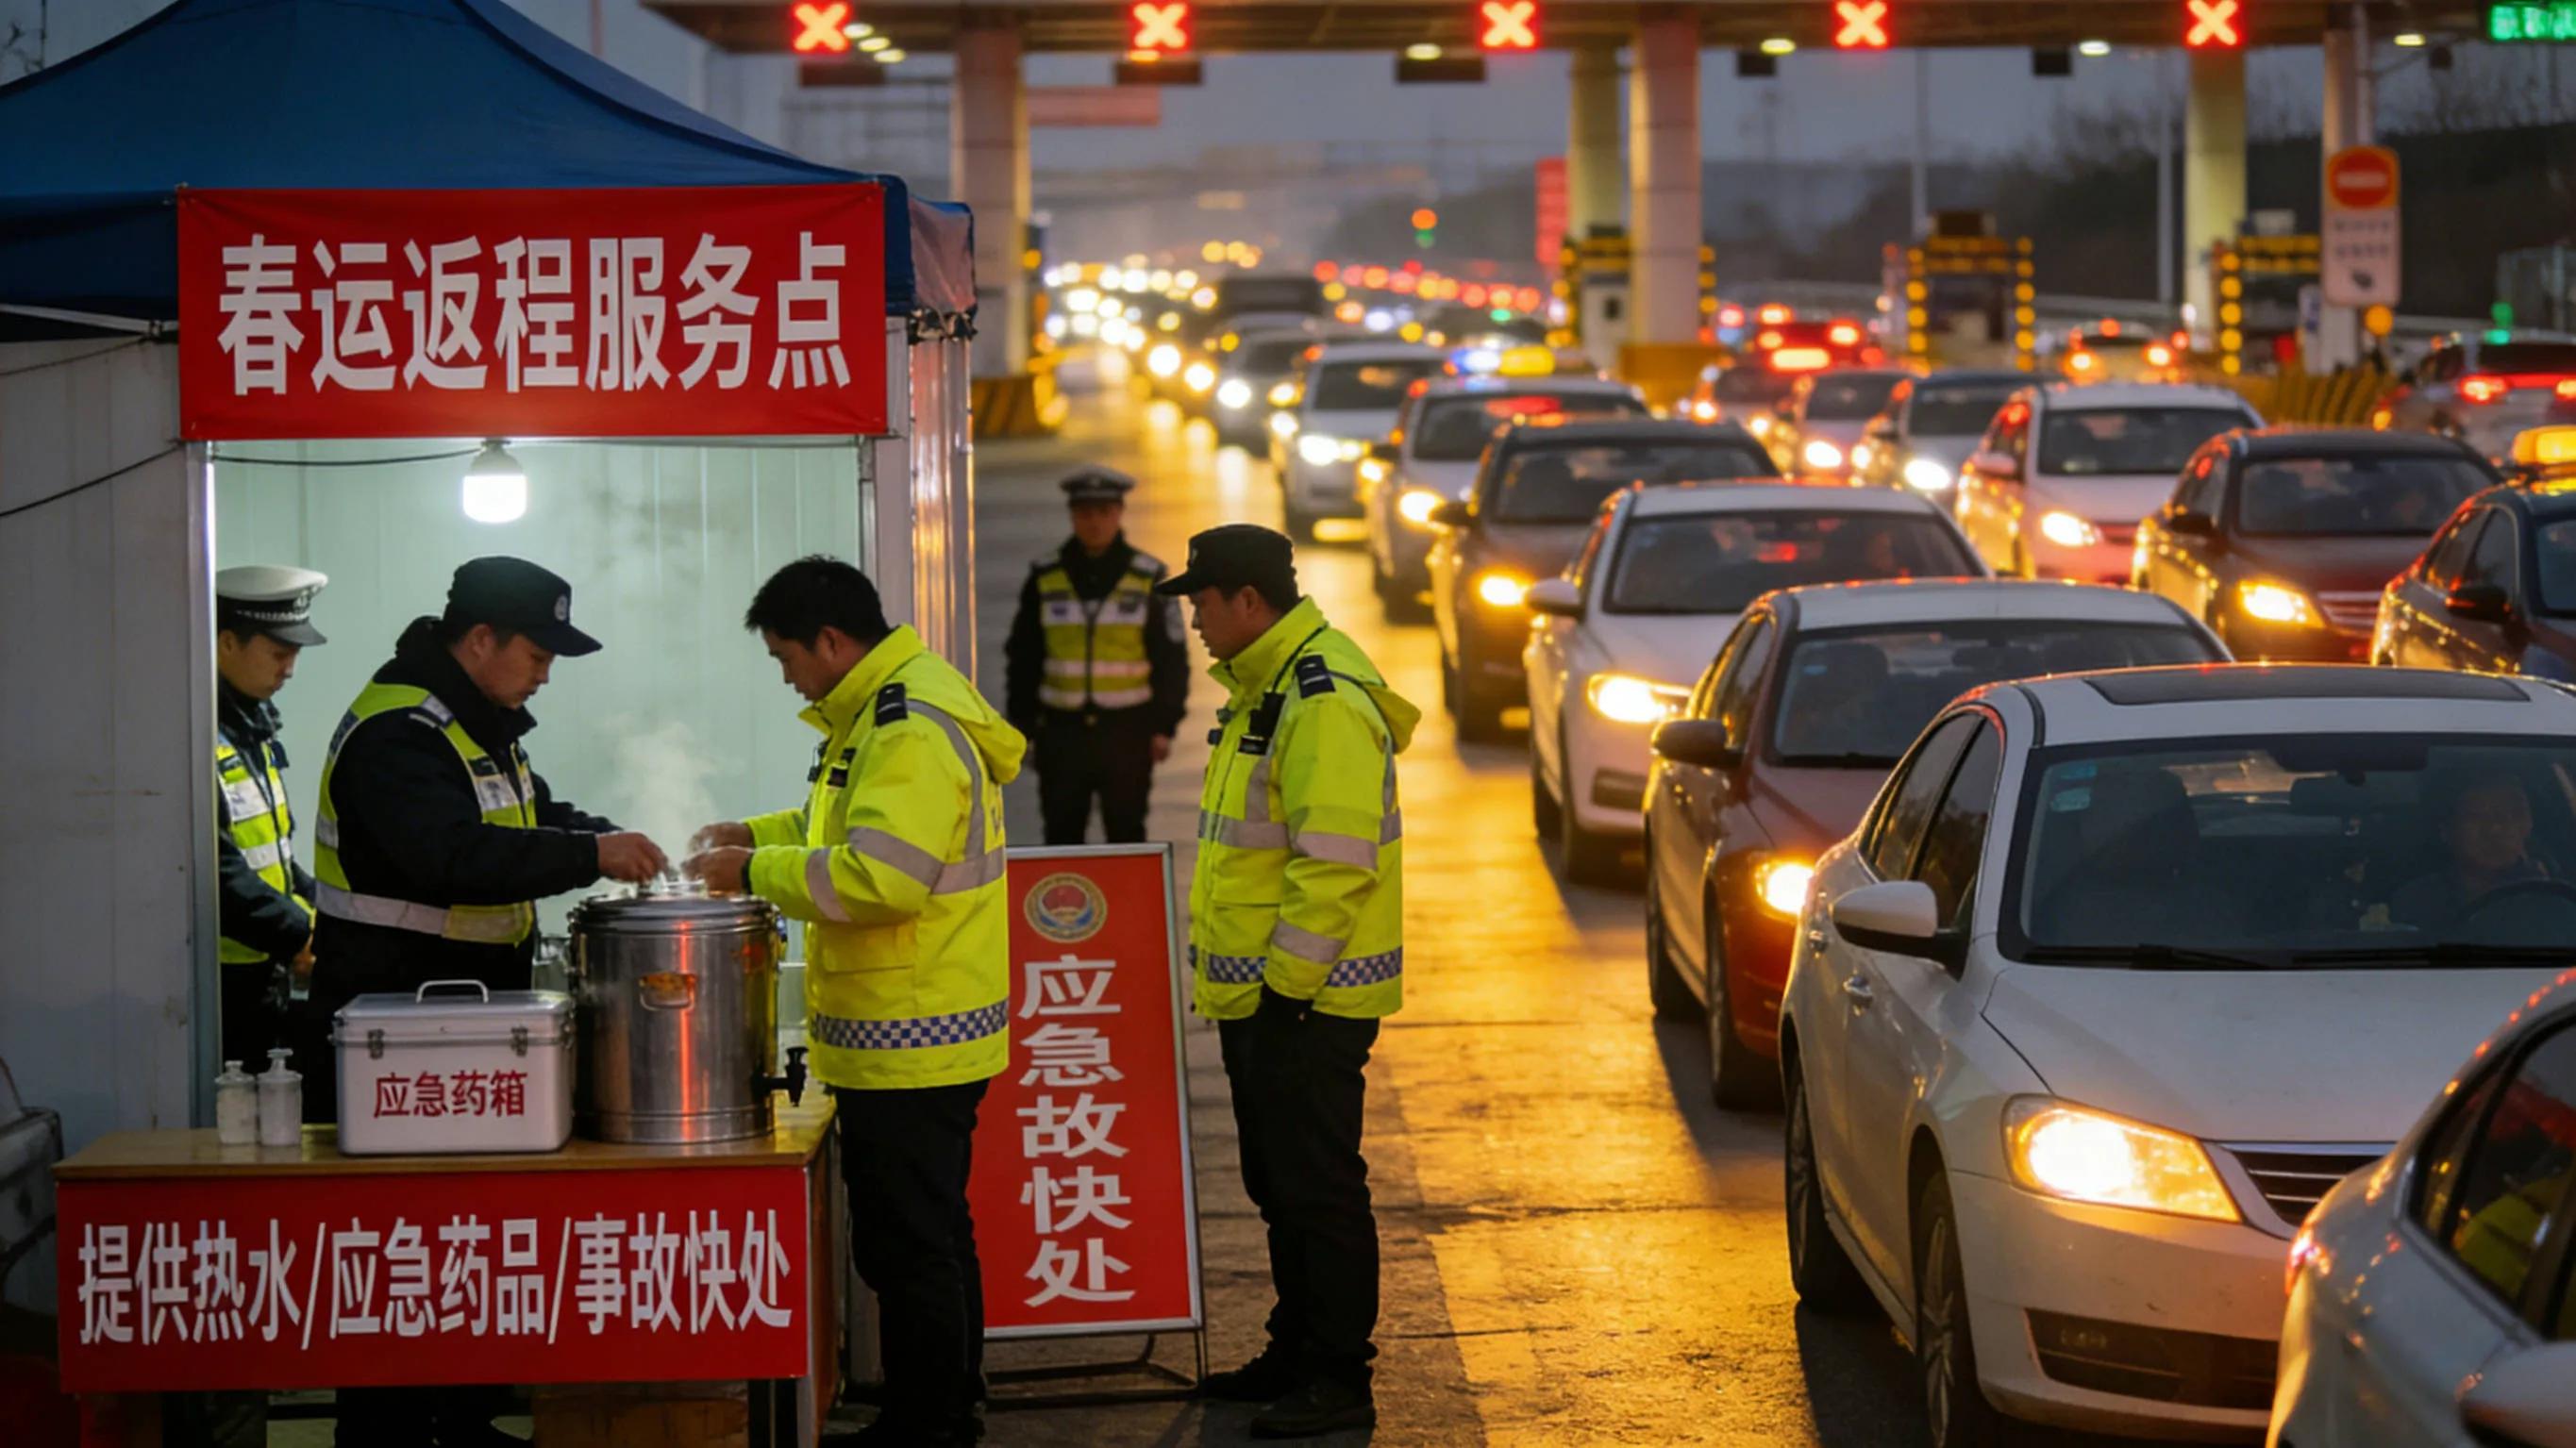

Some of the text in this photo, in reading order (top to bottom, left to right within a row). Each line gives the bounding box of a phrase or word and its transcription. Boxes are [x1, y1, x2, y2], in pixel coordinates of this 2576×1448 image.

[218, 231, 849, 395] 春运返程服务点
[374, 1070, 528, 1118] 应急药箱
[1016, 954, 1136, 1307] 应急故快处
[78, 1208, 793, 1350] 提供热水/应急药品/事故快处
